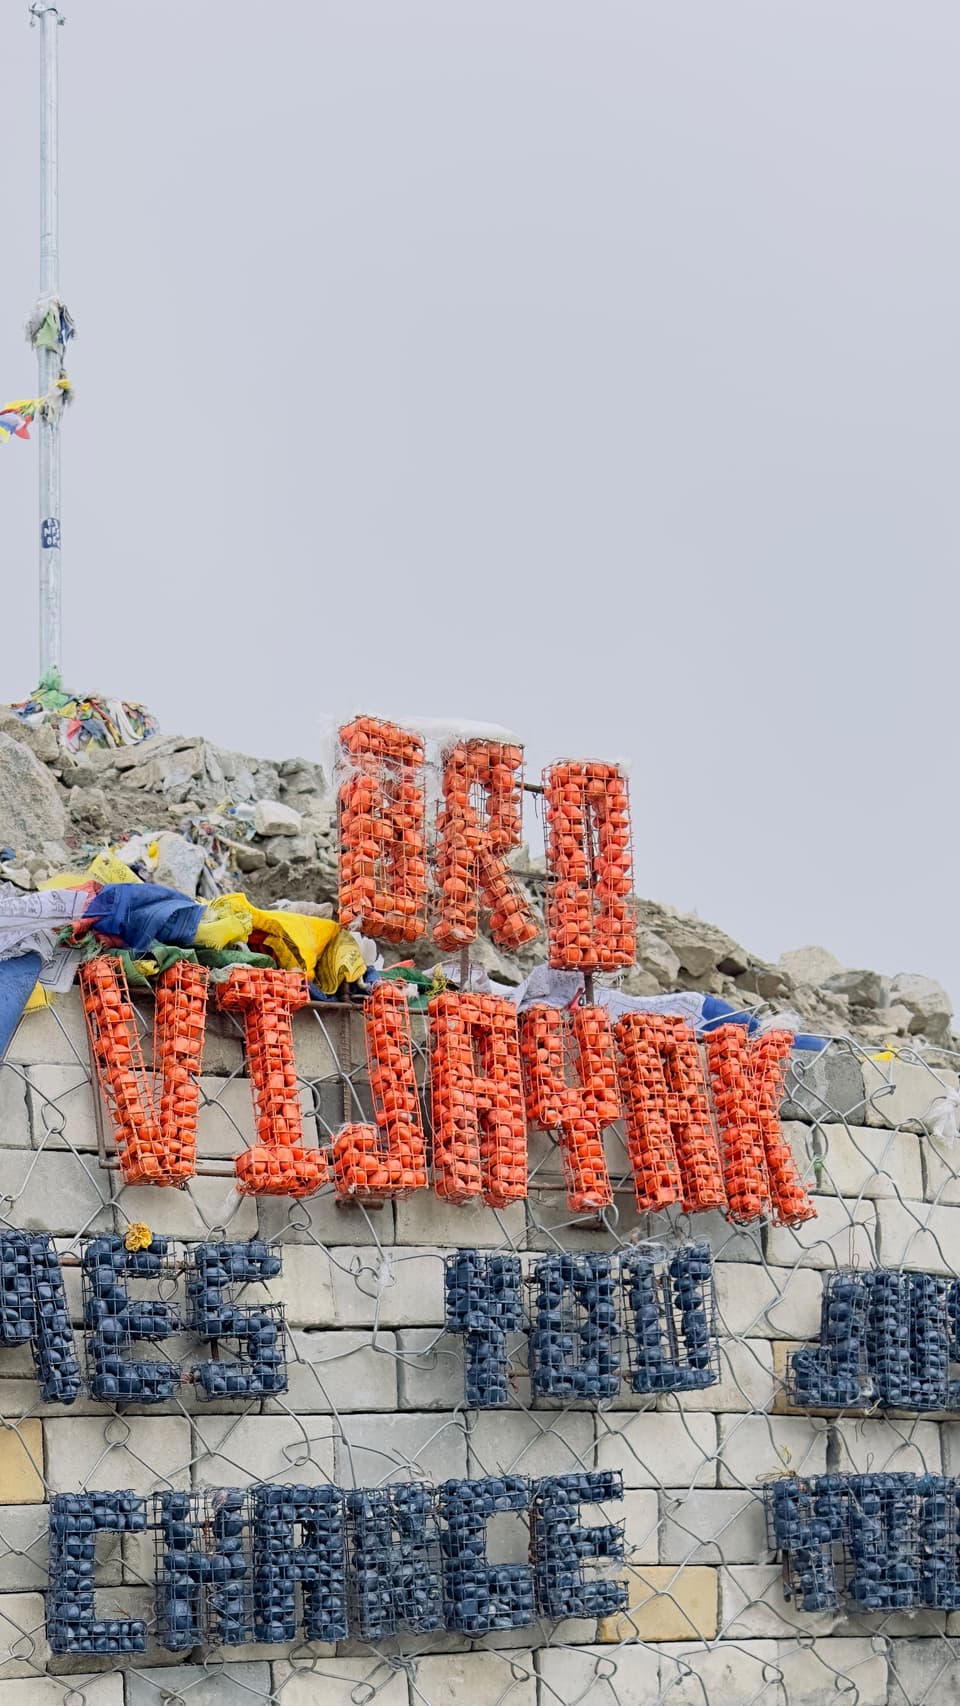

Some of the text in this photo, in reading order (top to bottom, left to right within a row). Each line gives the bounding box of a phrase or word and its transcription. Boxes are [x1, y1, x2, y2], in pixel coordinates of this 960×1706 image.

[338, 714, 638, 972] BRO
[79, 953, 819, 1228] VIJAYAK
[444, 1240, 721, 1405] YOU
[46, 1468, 630, 1657] CHANGE
